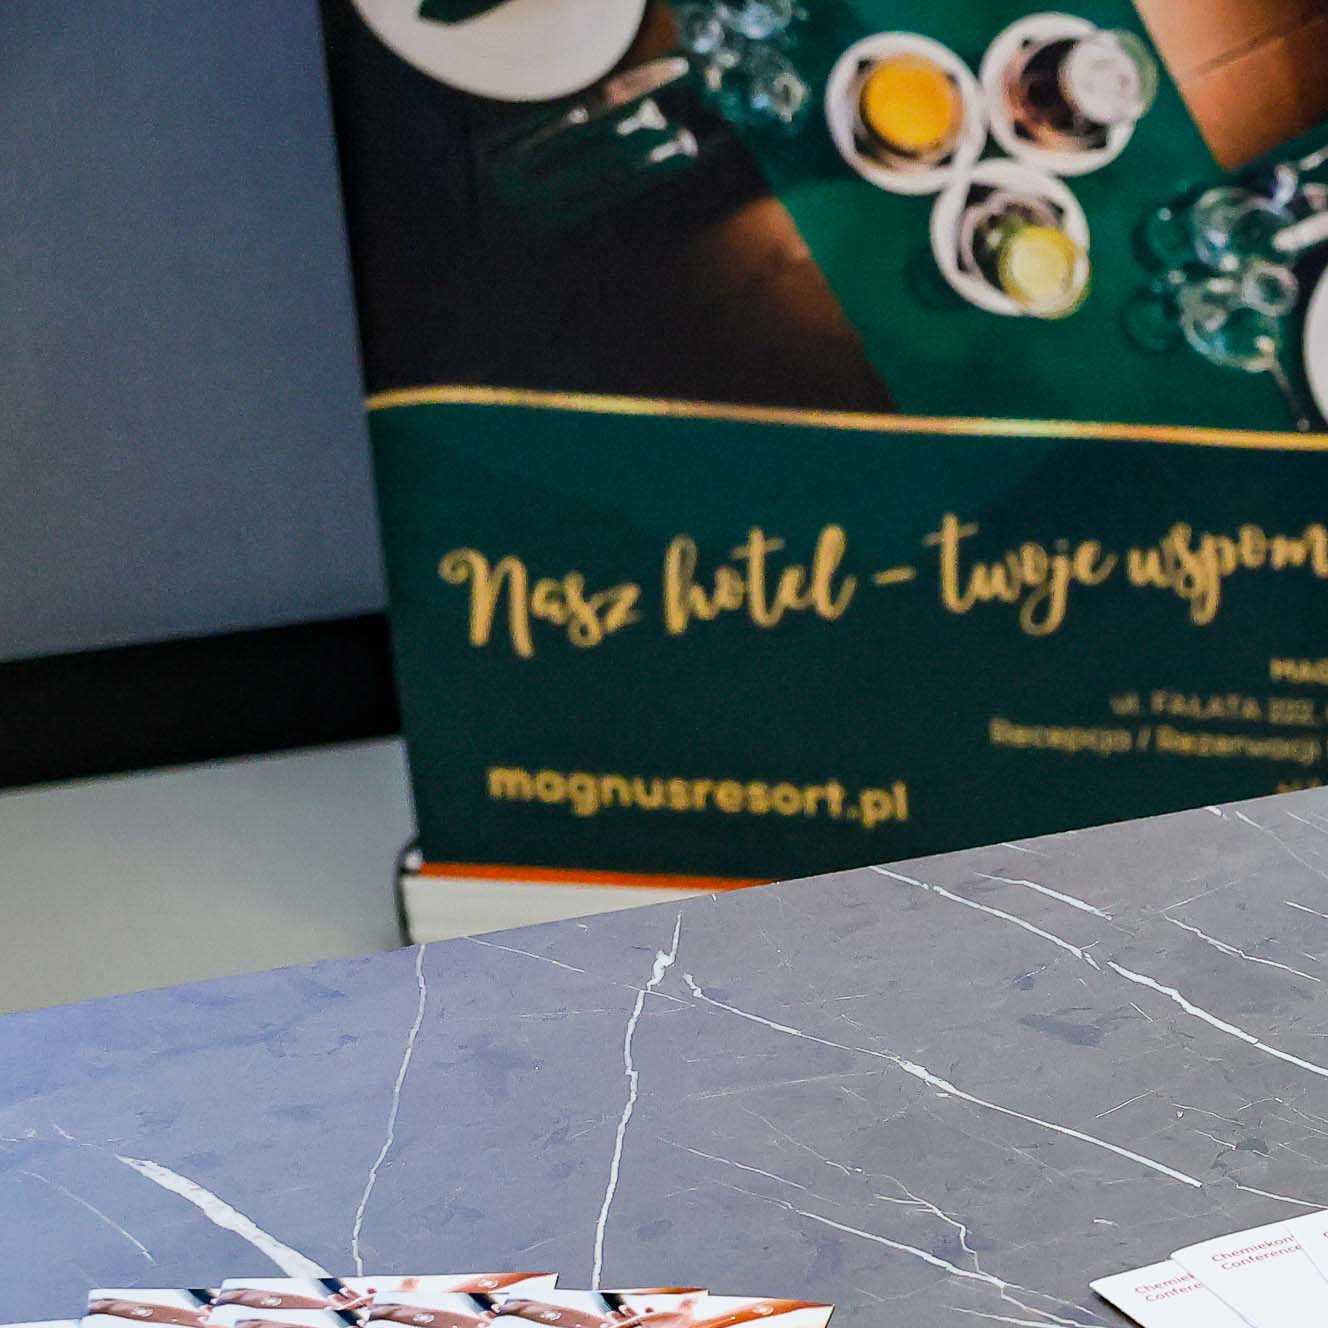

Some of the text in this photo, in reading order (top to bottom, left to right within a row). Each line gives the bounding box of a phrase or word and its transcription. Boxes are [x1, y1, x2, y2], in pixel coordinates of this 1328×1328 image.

[438, 545, 642, 656] Nasz
[666, 524, 858, 634] hotel
[913, 515, 1115, 637] twoje
[487, 763, 908, 828] magnusresort.pl
